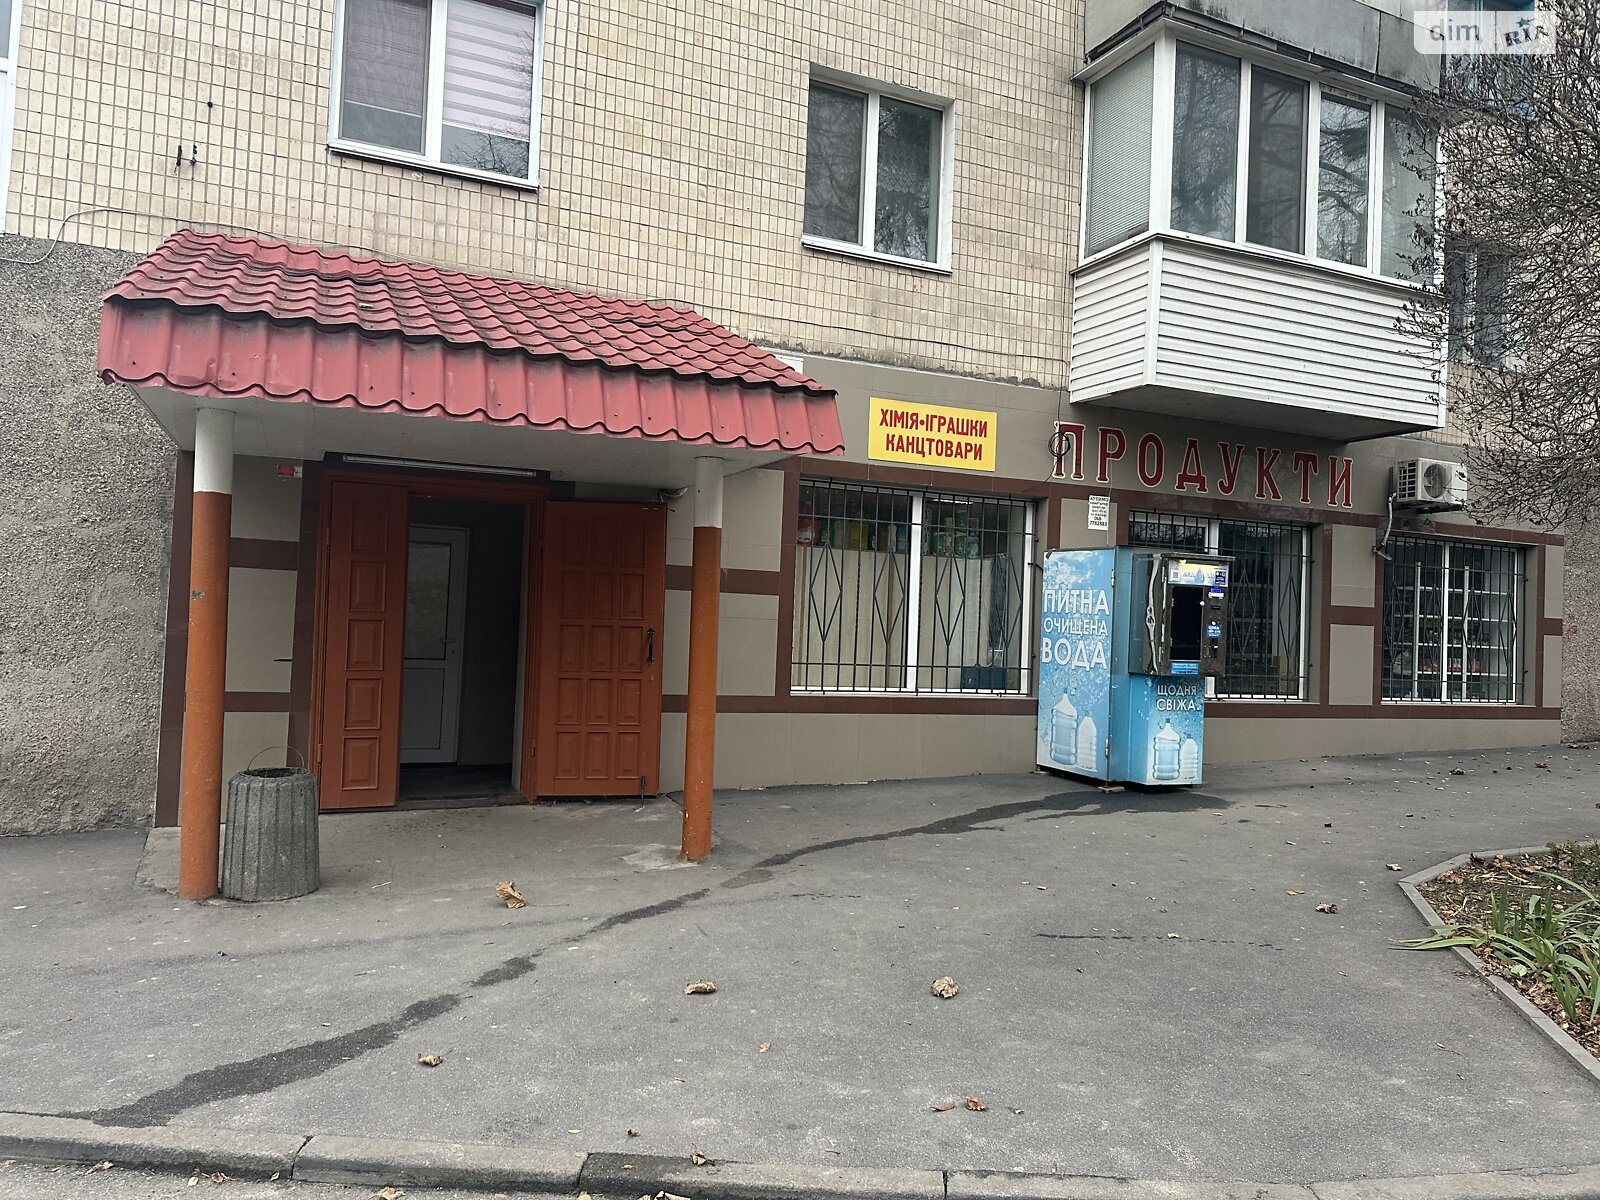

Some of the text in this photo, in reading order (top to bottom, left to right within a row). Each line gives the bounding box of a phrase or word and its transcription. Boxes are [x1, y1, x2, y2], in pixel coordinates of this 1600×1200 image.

[885, 433, 983, 461] КАНЦТОВАРИ
[1052, 420, 1353, 508] ПРОДУКТИ
[1043, 589, 1110, 616] ПИТНА
[1043, 616, 1109, 637] ОЧИЩЕНА
[1041, 637, 1108, 672] ВОДА
[1157, 684, 1197, 697] ЩОДНЯ
